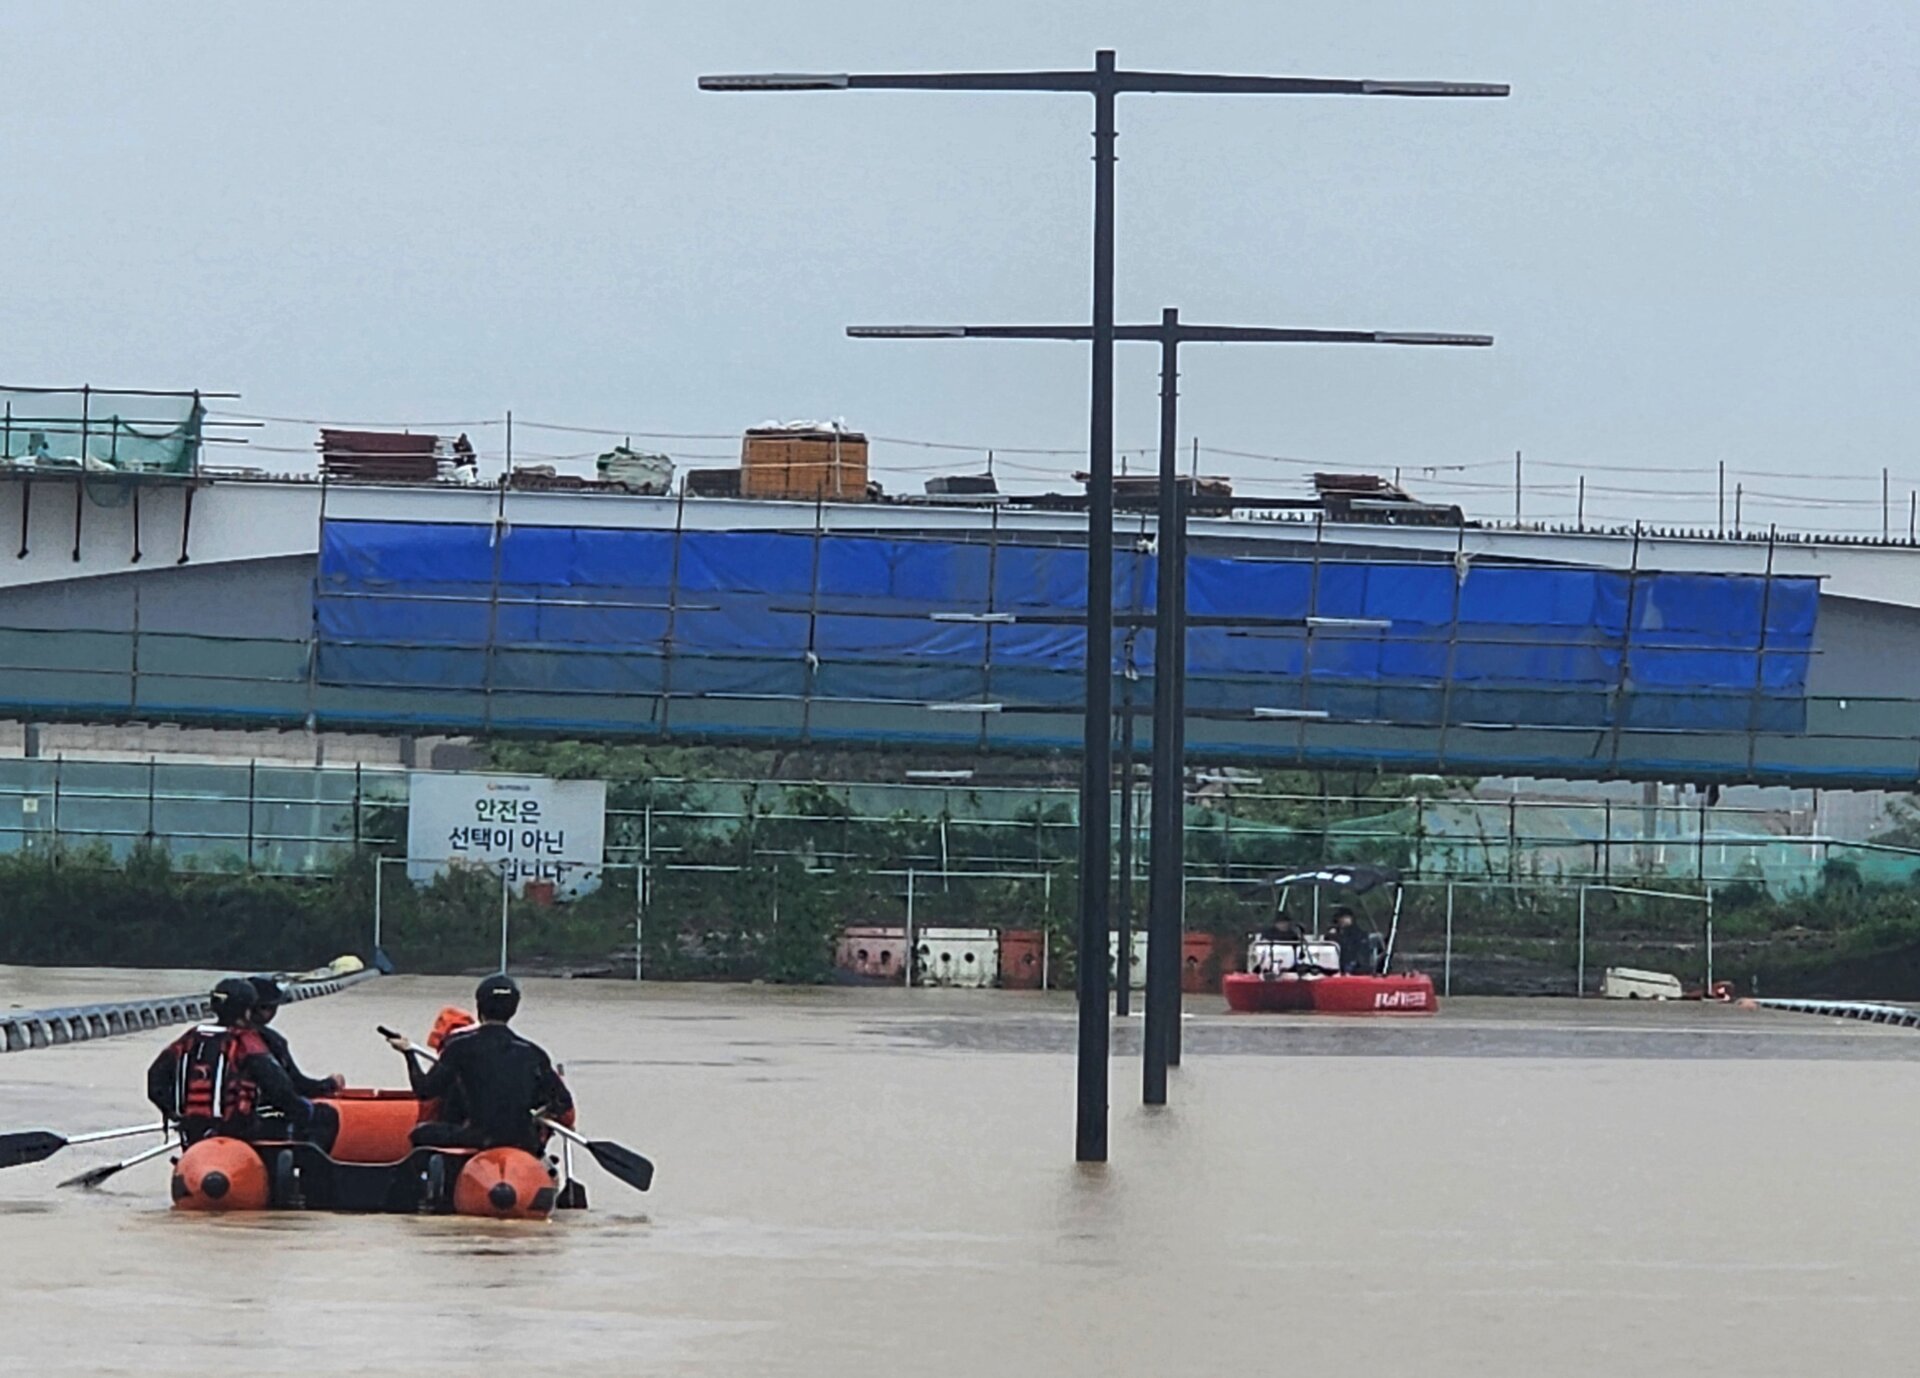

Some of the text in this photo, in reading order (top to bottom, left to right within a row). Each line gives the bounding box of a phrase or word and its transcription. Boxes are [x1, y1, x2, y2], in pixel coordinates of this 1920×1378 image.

[475, 798, 541, 824] 안전은
[448, 826, 564, 855] 선택이 아닌
